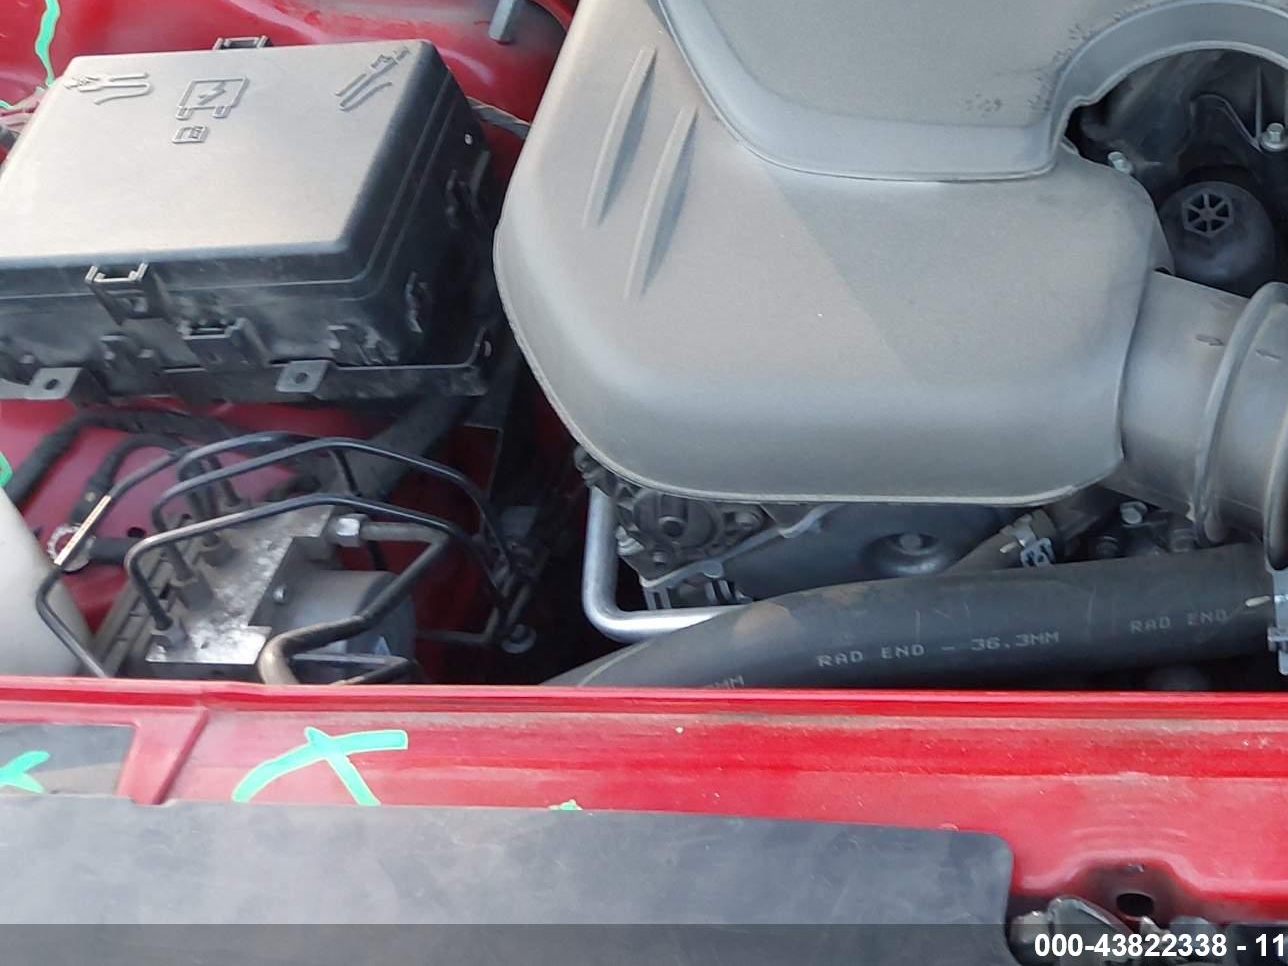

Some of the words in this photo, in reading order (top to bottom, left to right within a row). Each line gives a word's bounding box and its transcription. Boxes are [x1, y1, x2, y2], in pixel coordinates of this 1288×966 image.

[1129, 617, 1171, 633] RAD
[1186, 609, 1227, 626] END
[817, 650, 864, 667] RAD
[881, 644, 925, 659] END
[971, 632, 1060, 651] 36.3MM
